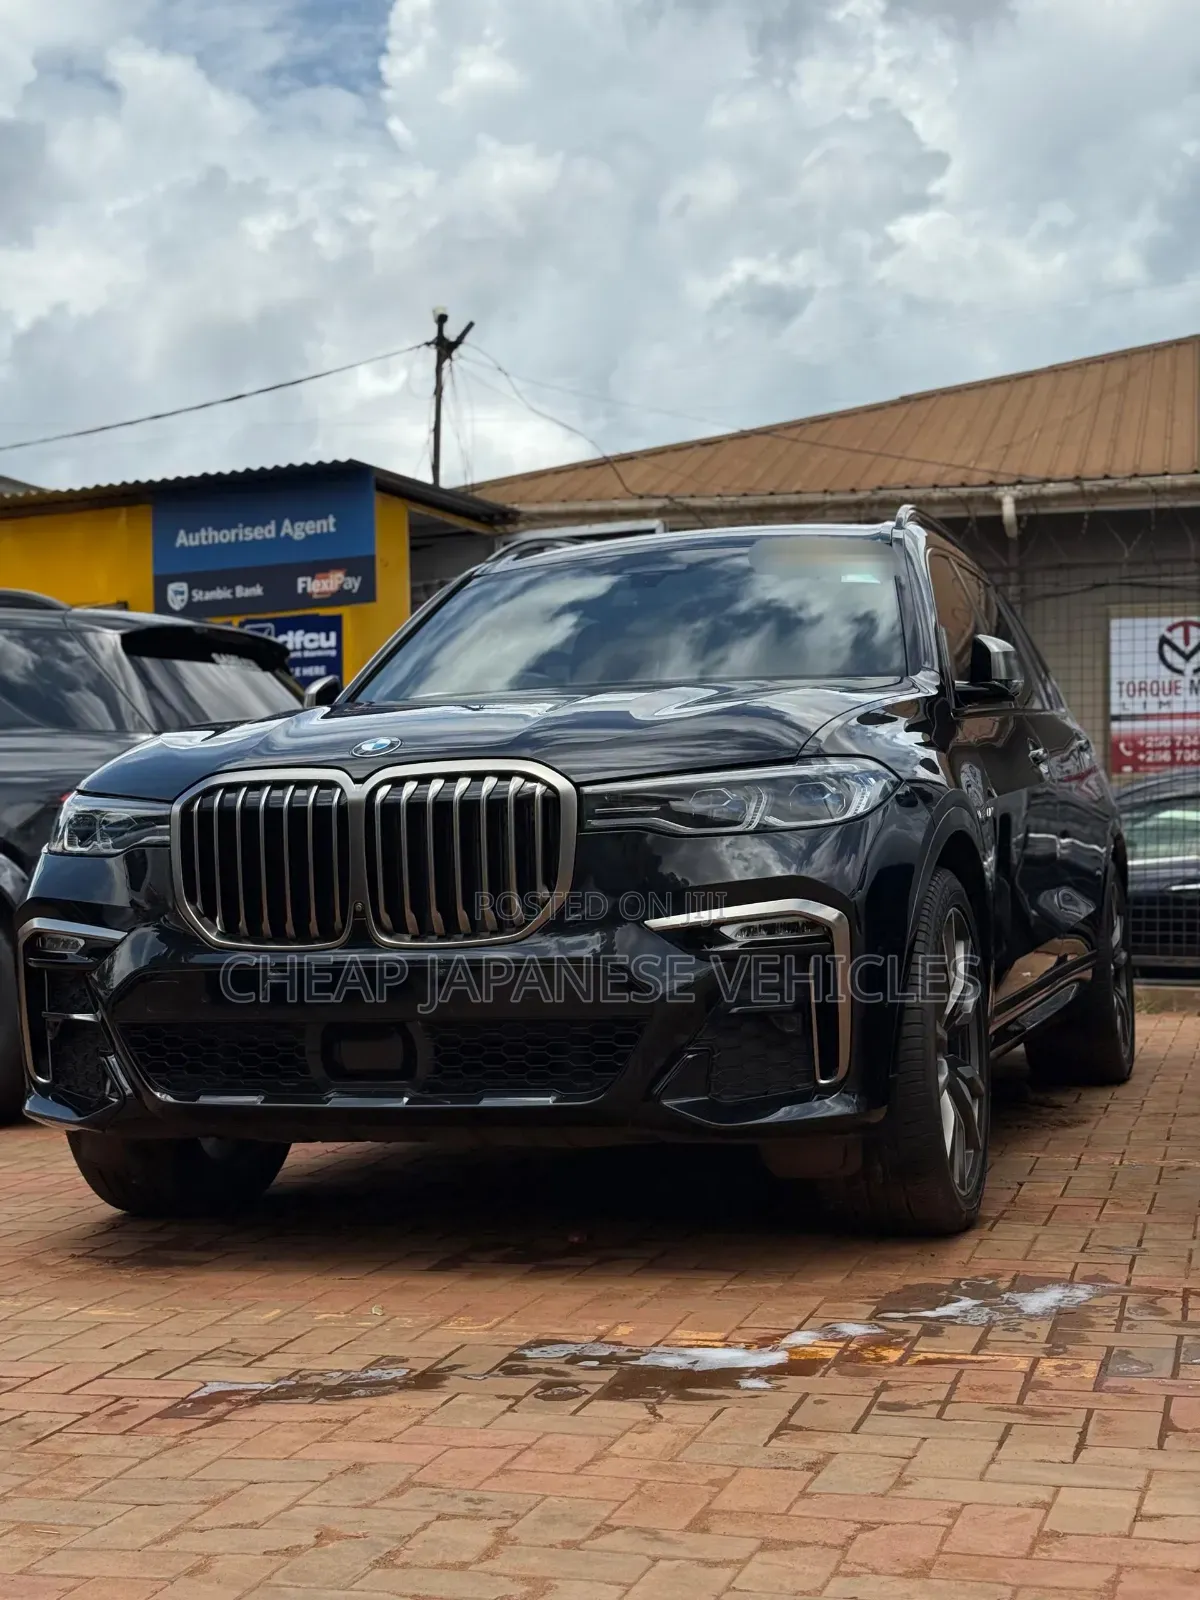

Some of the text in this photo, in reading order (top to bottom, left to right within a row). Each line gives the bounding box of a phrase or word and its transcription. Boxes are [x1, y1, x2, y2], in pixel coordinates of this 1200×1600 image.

[175, 514, 336, 548] Authorised Agent
[191, 583, 264, 602] Stanbic Bank
[297, 571, 362, 594] FlexiPay
[277, 629, 337, 651] dfcu
[1116, 680, 1183, 698] TORQUE
